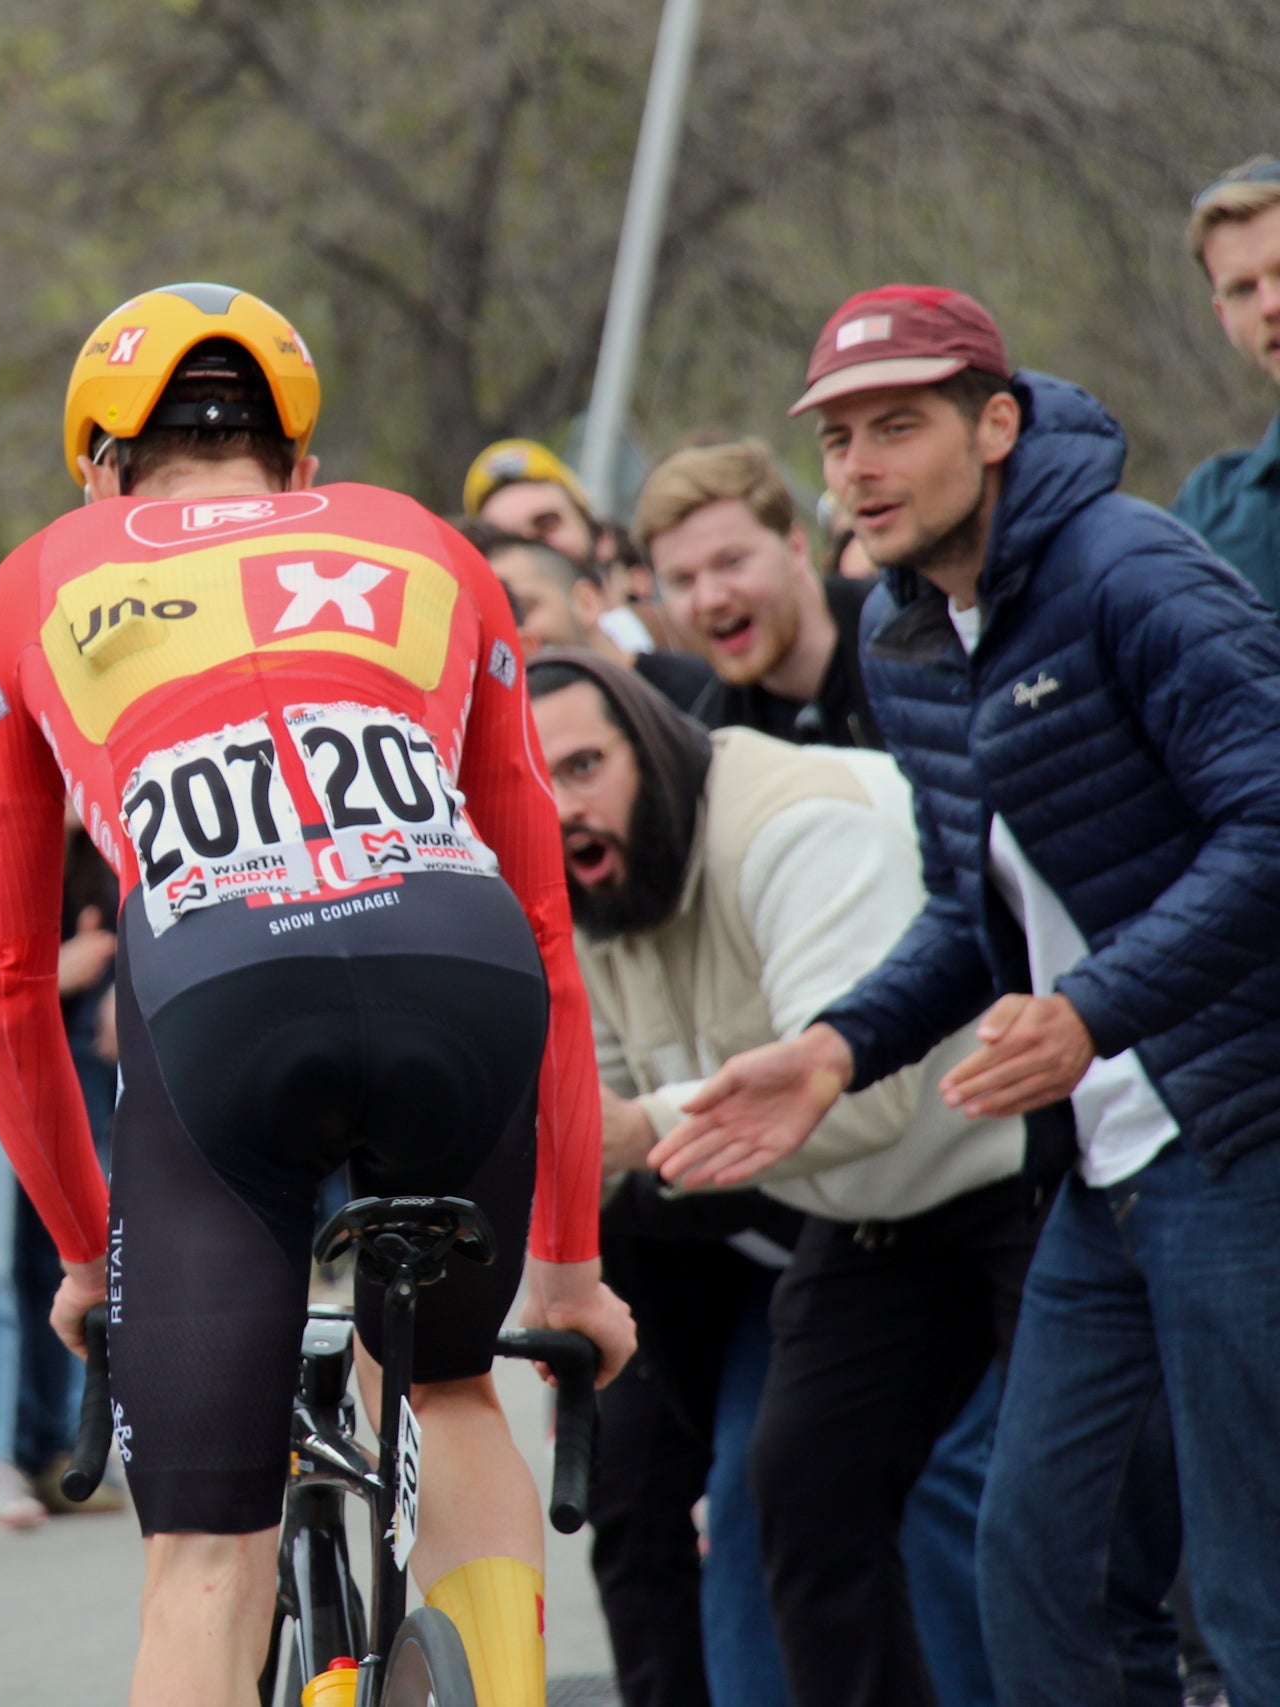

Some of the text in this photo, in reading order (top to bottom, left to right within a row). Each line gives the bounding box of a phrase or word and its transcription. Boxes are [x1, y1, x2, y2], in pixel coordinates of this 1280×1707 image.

[109, 329, 145, 362] X
[273, 561, 392, 633] X
[123, 738, 281, 891] 207
[214, 867, 288, 888] MODYF
[269, 890, 400, 935] SHOW COURAGE!
[110, 1218, 123, 1324] RETAIL
[402, 1410, 419, 1536] 207
